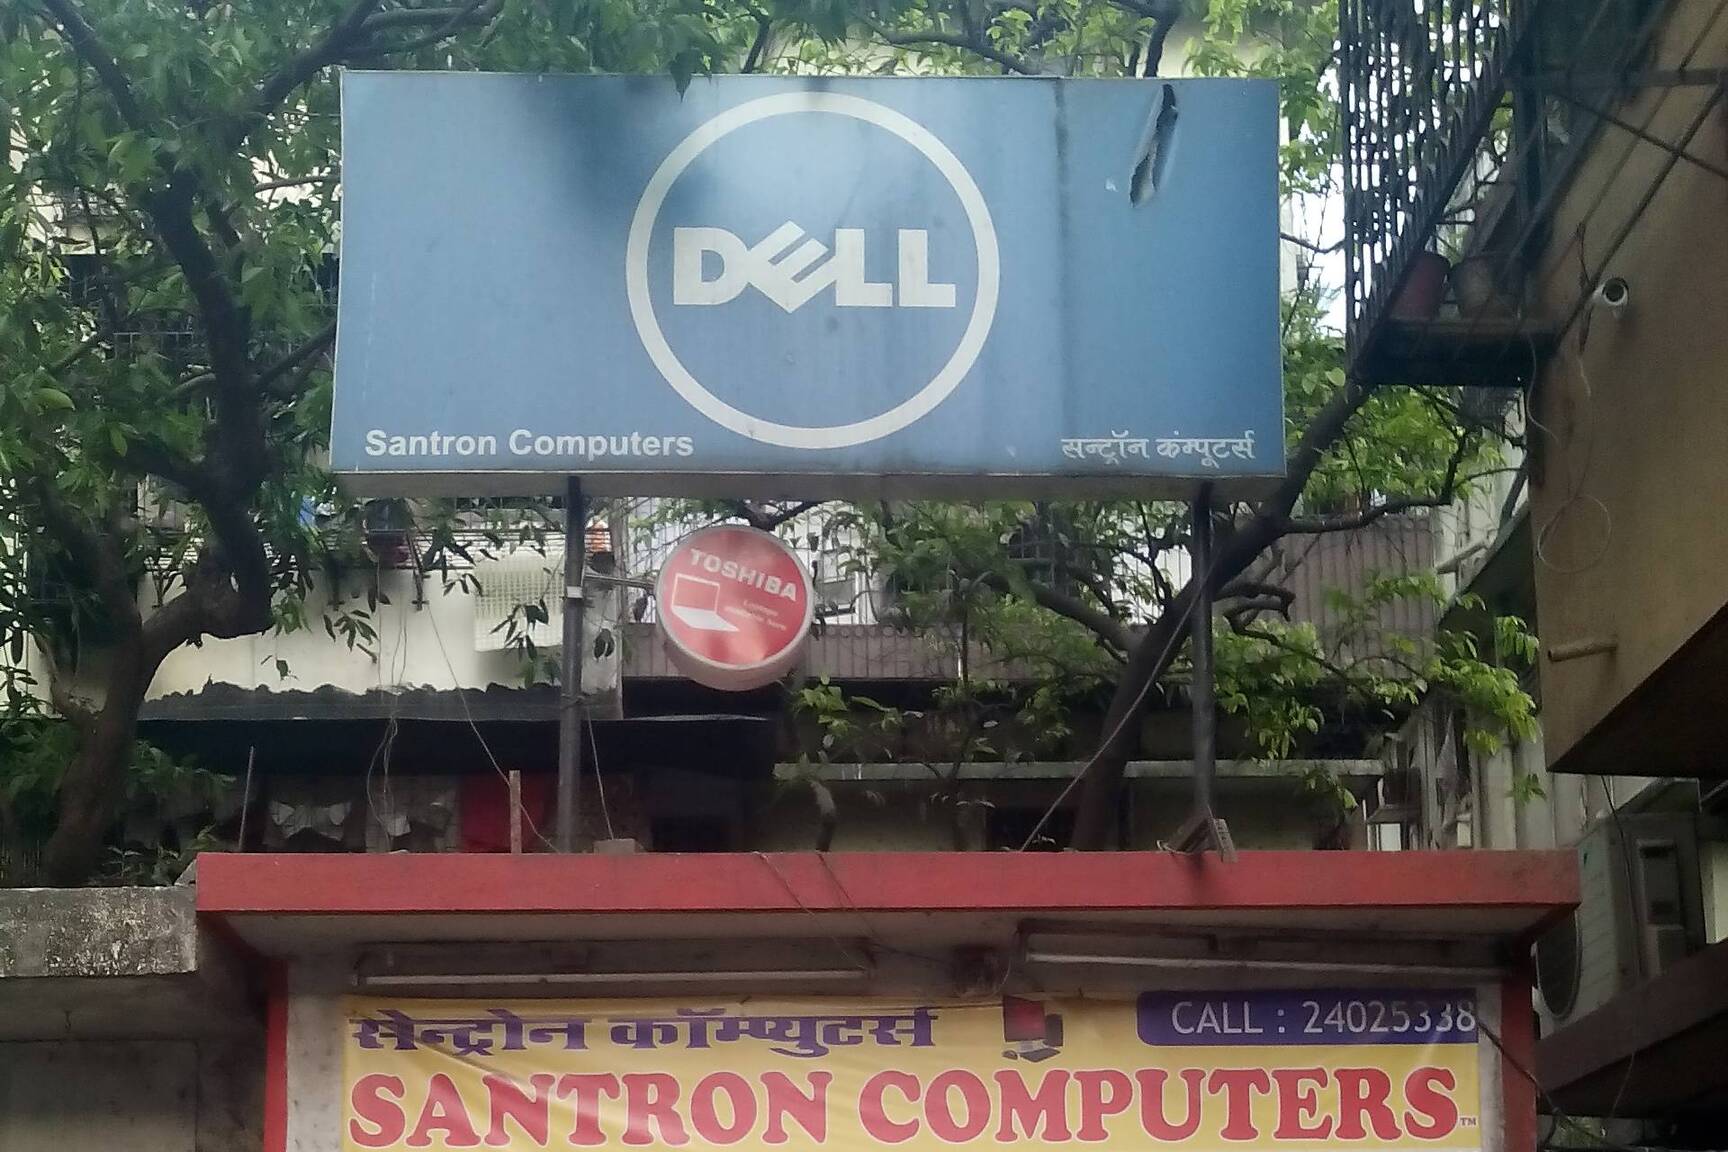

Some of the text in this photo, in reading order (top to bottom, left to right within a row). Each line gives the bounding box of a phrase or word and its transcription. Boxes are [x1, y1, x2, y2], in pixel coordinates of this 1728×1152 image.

[673, 221, 956, 313] DELL
[365, 429, 694, 461] Santron Computers
[690, 548, 797, 602] TOSHIBA
[1172, 1001, 1263, 1034] CALL
[350, 1066, 1459, 1147] SANTRON COMPUTERS
